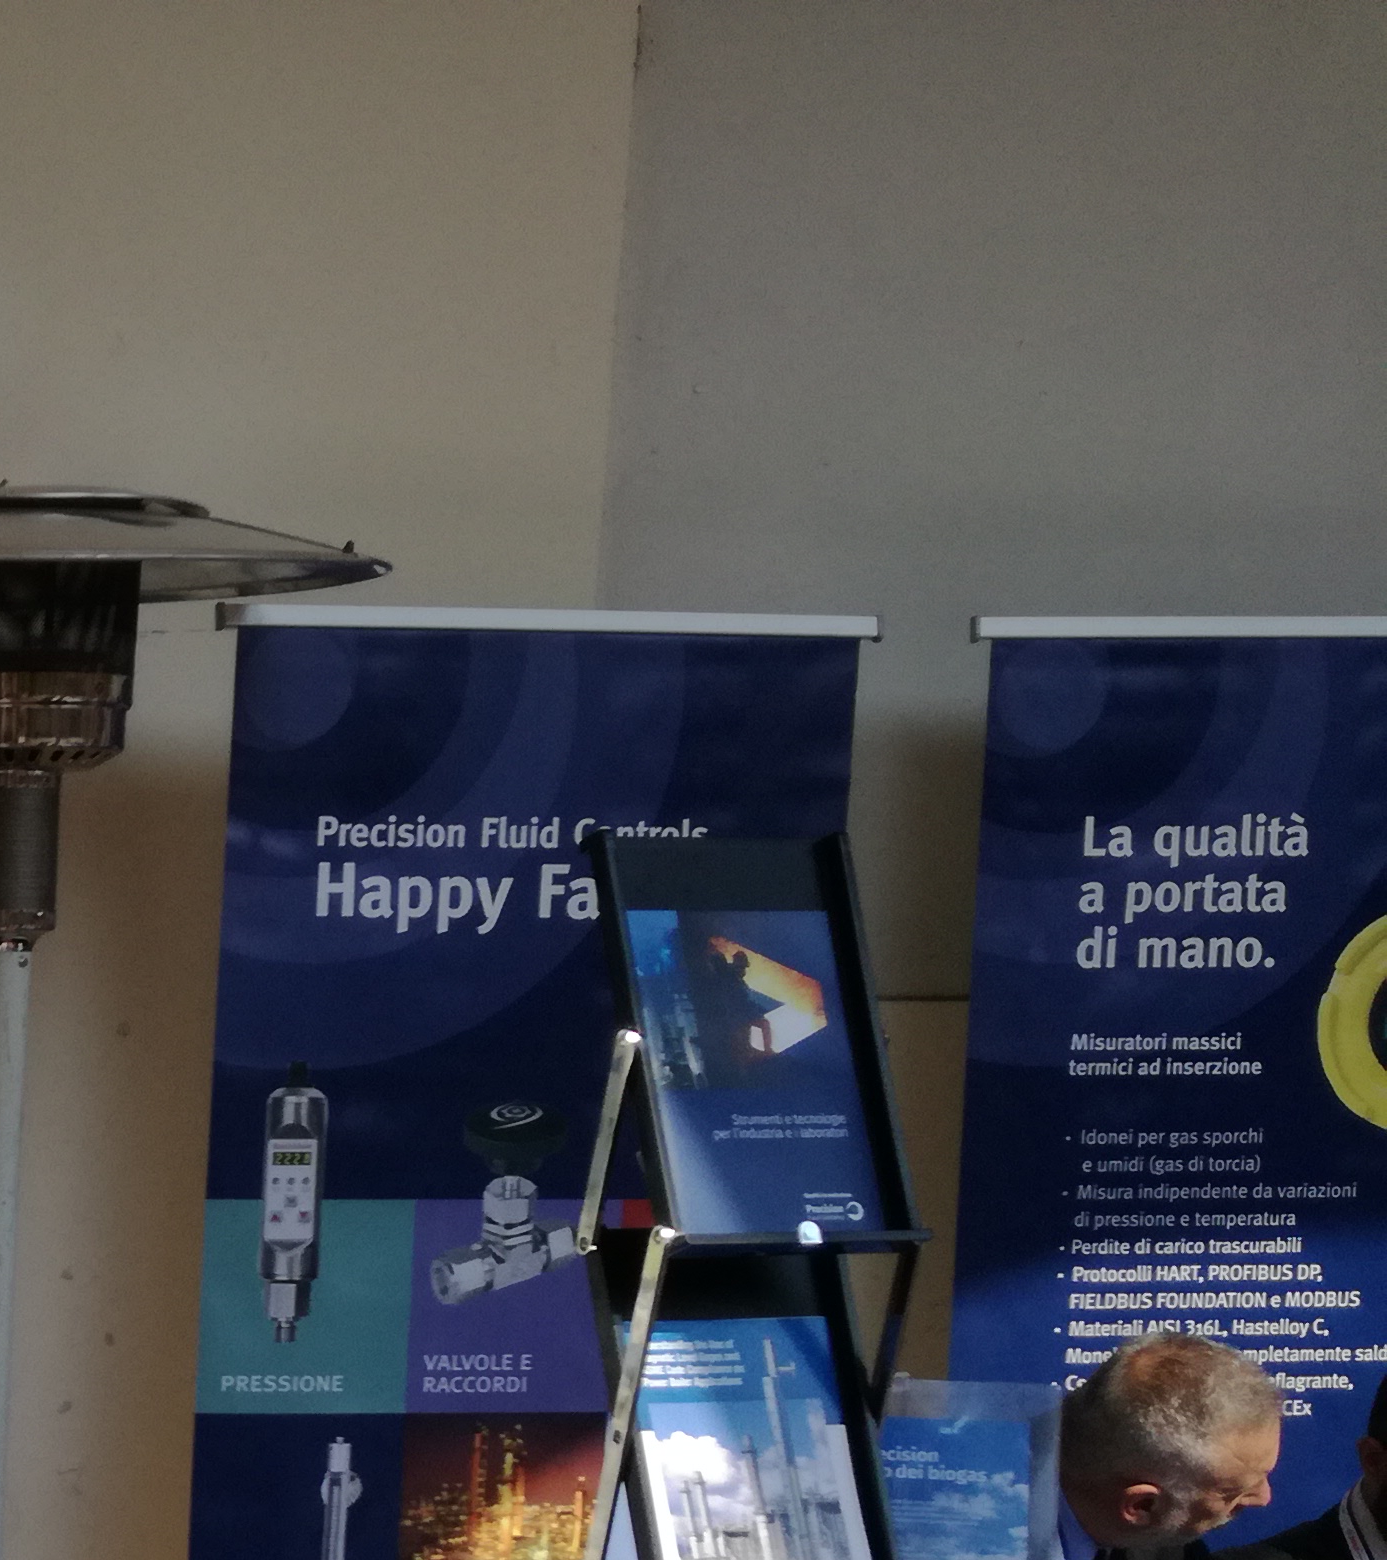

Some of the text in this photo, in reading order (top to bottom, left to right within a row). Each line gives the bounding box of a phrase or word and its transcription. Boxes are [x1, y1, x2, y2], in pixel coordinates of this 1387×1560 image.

[317, 814, 466, 849] Precision
[481, 816, 559, 848] Fluid
[1083, 812, 1308, 868] La qualità
[314, 861, 513, 933] Happy
[1078, 873, 1287, 924] a portata
[1076, 925, 1276, 968] di mano.
[1071, 1032, 1242, 1050] Misuratori massici
[1068, 1057, 1262, 1076] termici ad inserzione
[1081, 1128, 1263, 1148] Idonei per gas sporchi
[1082, 1154, 1261, 1176] e umidi (gas di torcia)
[1077, 1181, 1357, 1202] Misura indipendente da variazioni
[1074, 1209, 1296, 1231] di pressione e temperatura
[1071, 1236, 1302, 1255] Perdite di carico trascurabili
[1071, 1264, 1323, 1283] Protocolli HART, PROFIBUS DP,
[1068, 1290, 1361, 1310] FIELDBUS FOUNDATION e MODBUS
[1068, 1320, 1143, 1337] Materiali
[1187, 1319, 1228, 1337] 316L,
[1232, 1318, 1309, 1338] Hastelloy
[1312, 1318, 1330, 1336] C,
[424, 1354, 532, 1372] VALVOLE E
[221, 1375, 344, 1393] PRESSIONE
[423, 1375, 528, 1394] RACCORDI
[928, 1464, 988, 1485] biogas
